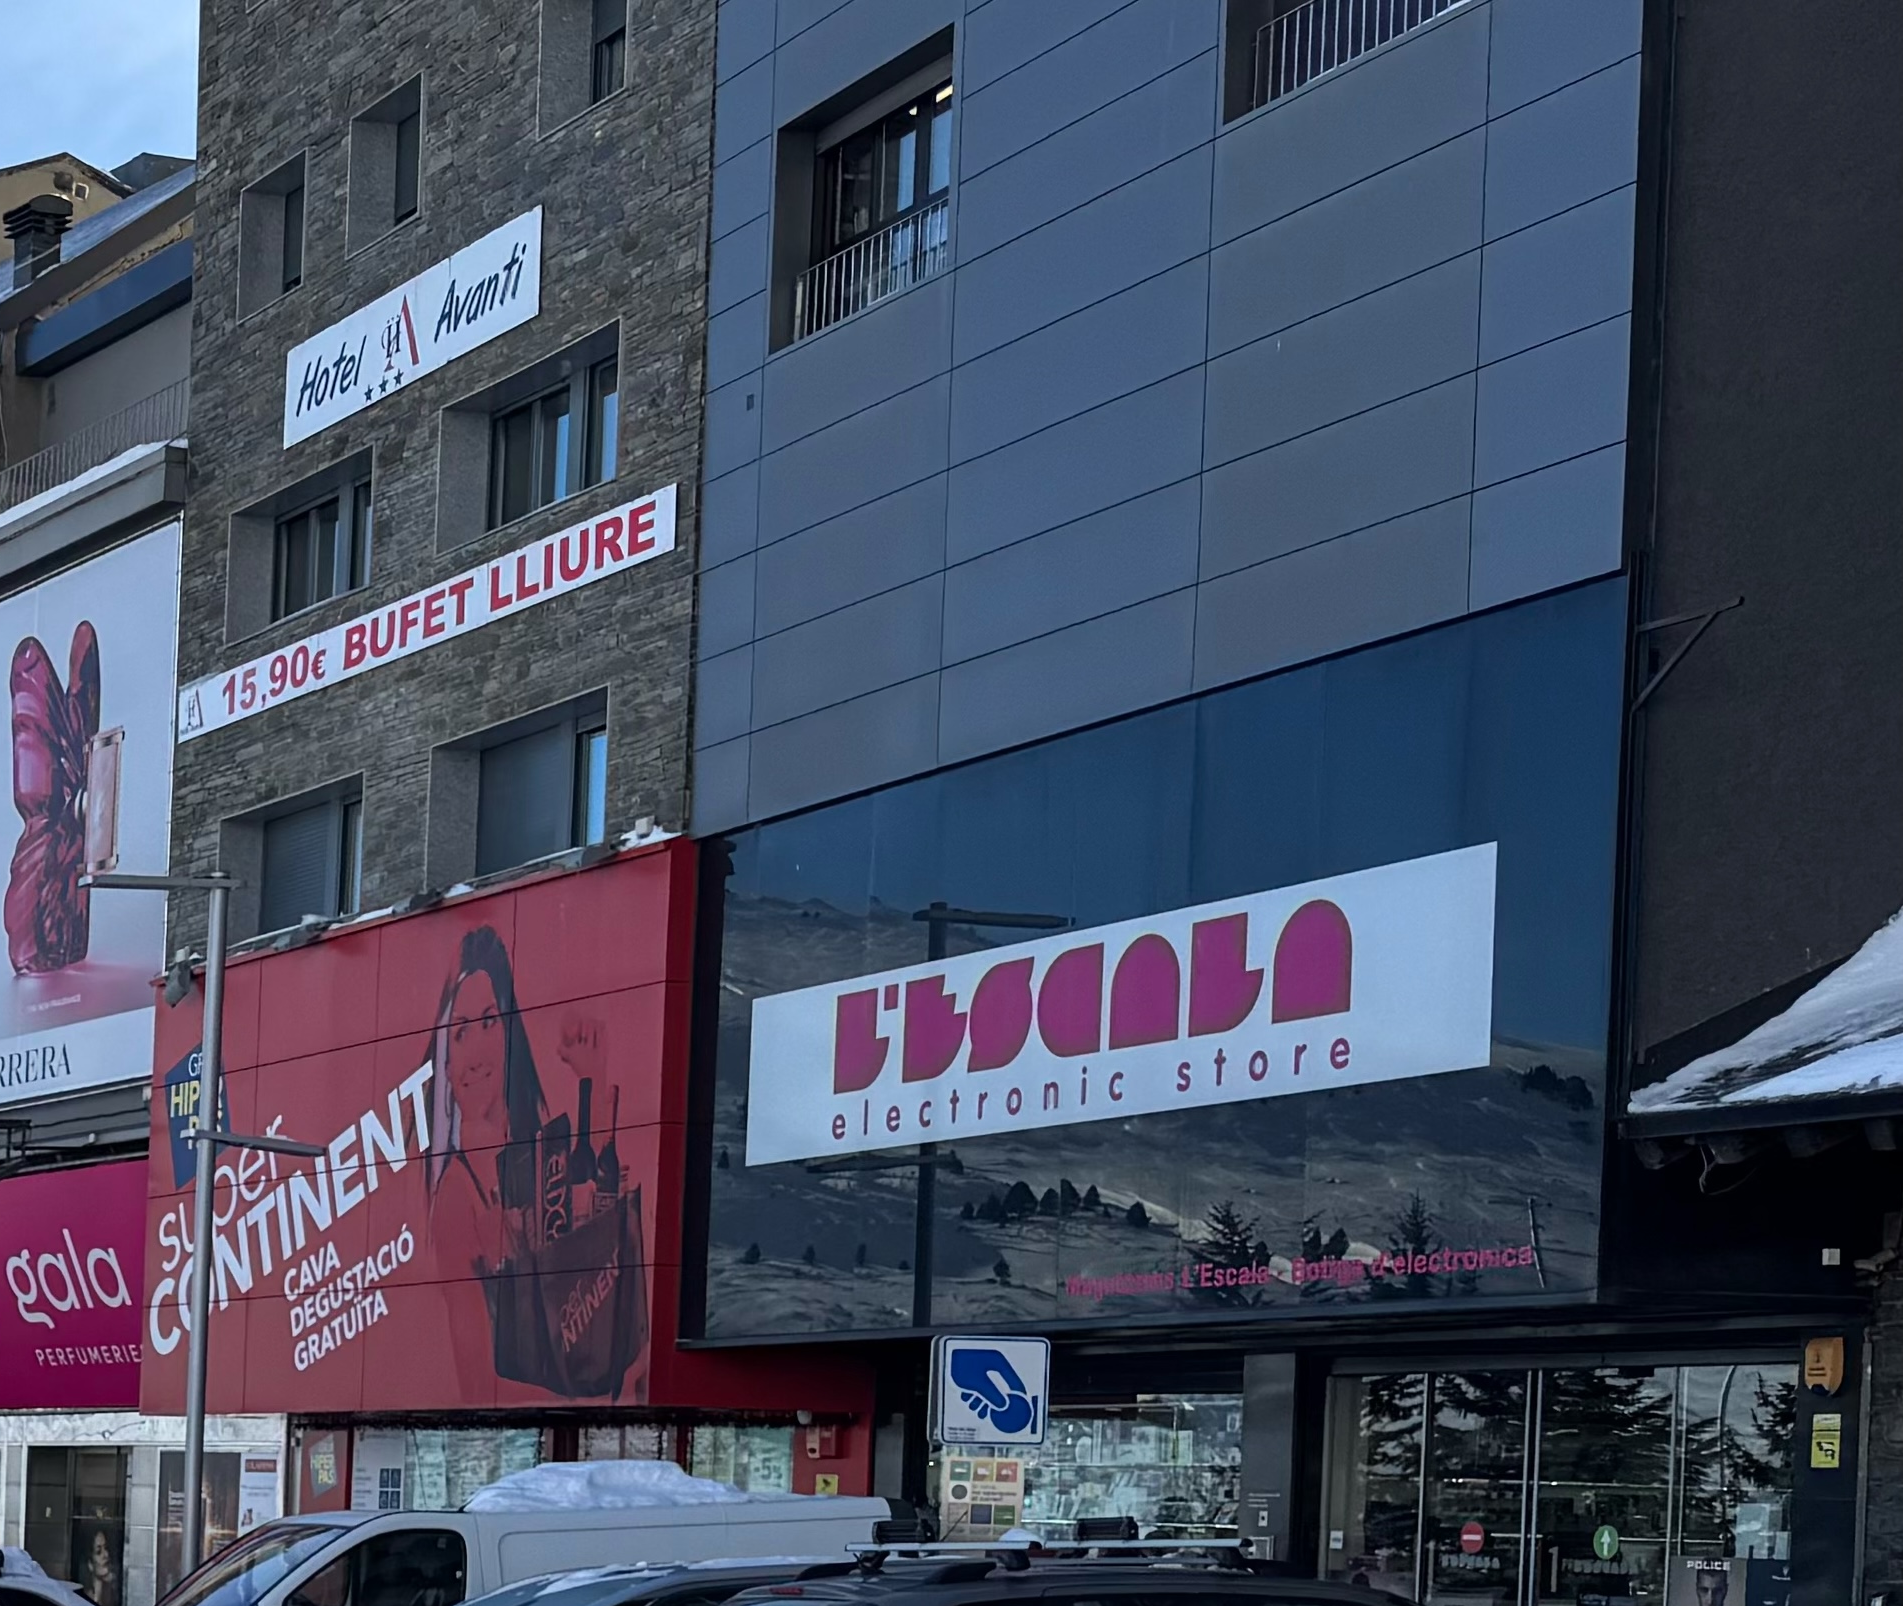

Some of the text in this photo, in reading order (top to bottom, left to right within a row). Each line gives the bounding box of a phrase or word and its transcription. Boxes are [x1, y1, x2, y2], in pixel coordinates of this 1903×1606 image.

[296, 243, 528, 418] Hotel Avanti
[221, 500, 657, 718] 15,90€ BUFET LLIURE
[830, 1035, 1353, 1142] electronic store
[6, 1228, 133, 1330] gala
[284, 1241, 341, 1301] CAVA
[290, 1223, 414, 1338] DEGUSTACIÓ
[35, 1344, 144, 1366] PERFUMERIE
[1687, 1560, 1731, 1571] POLICE
